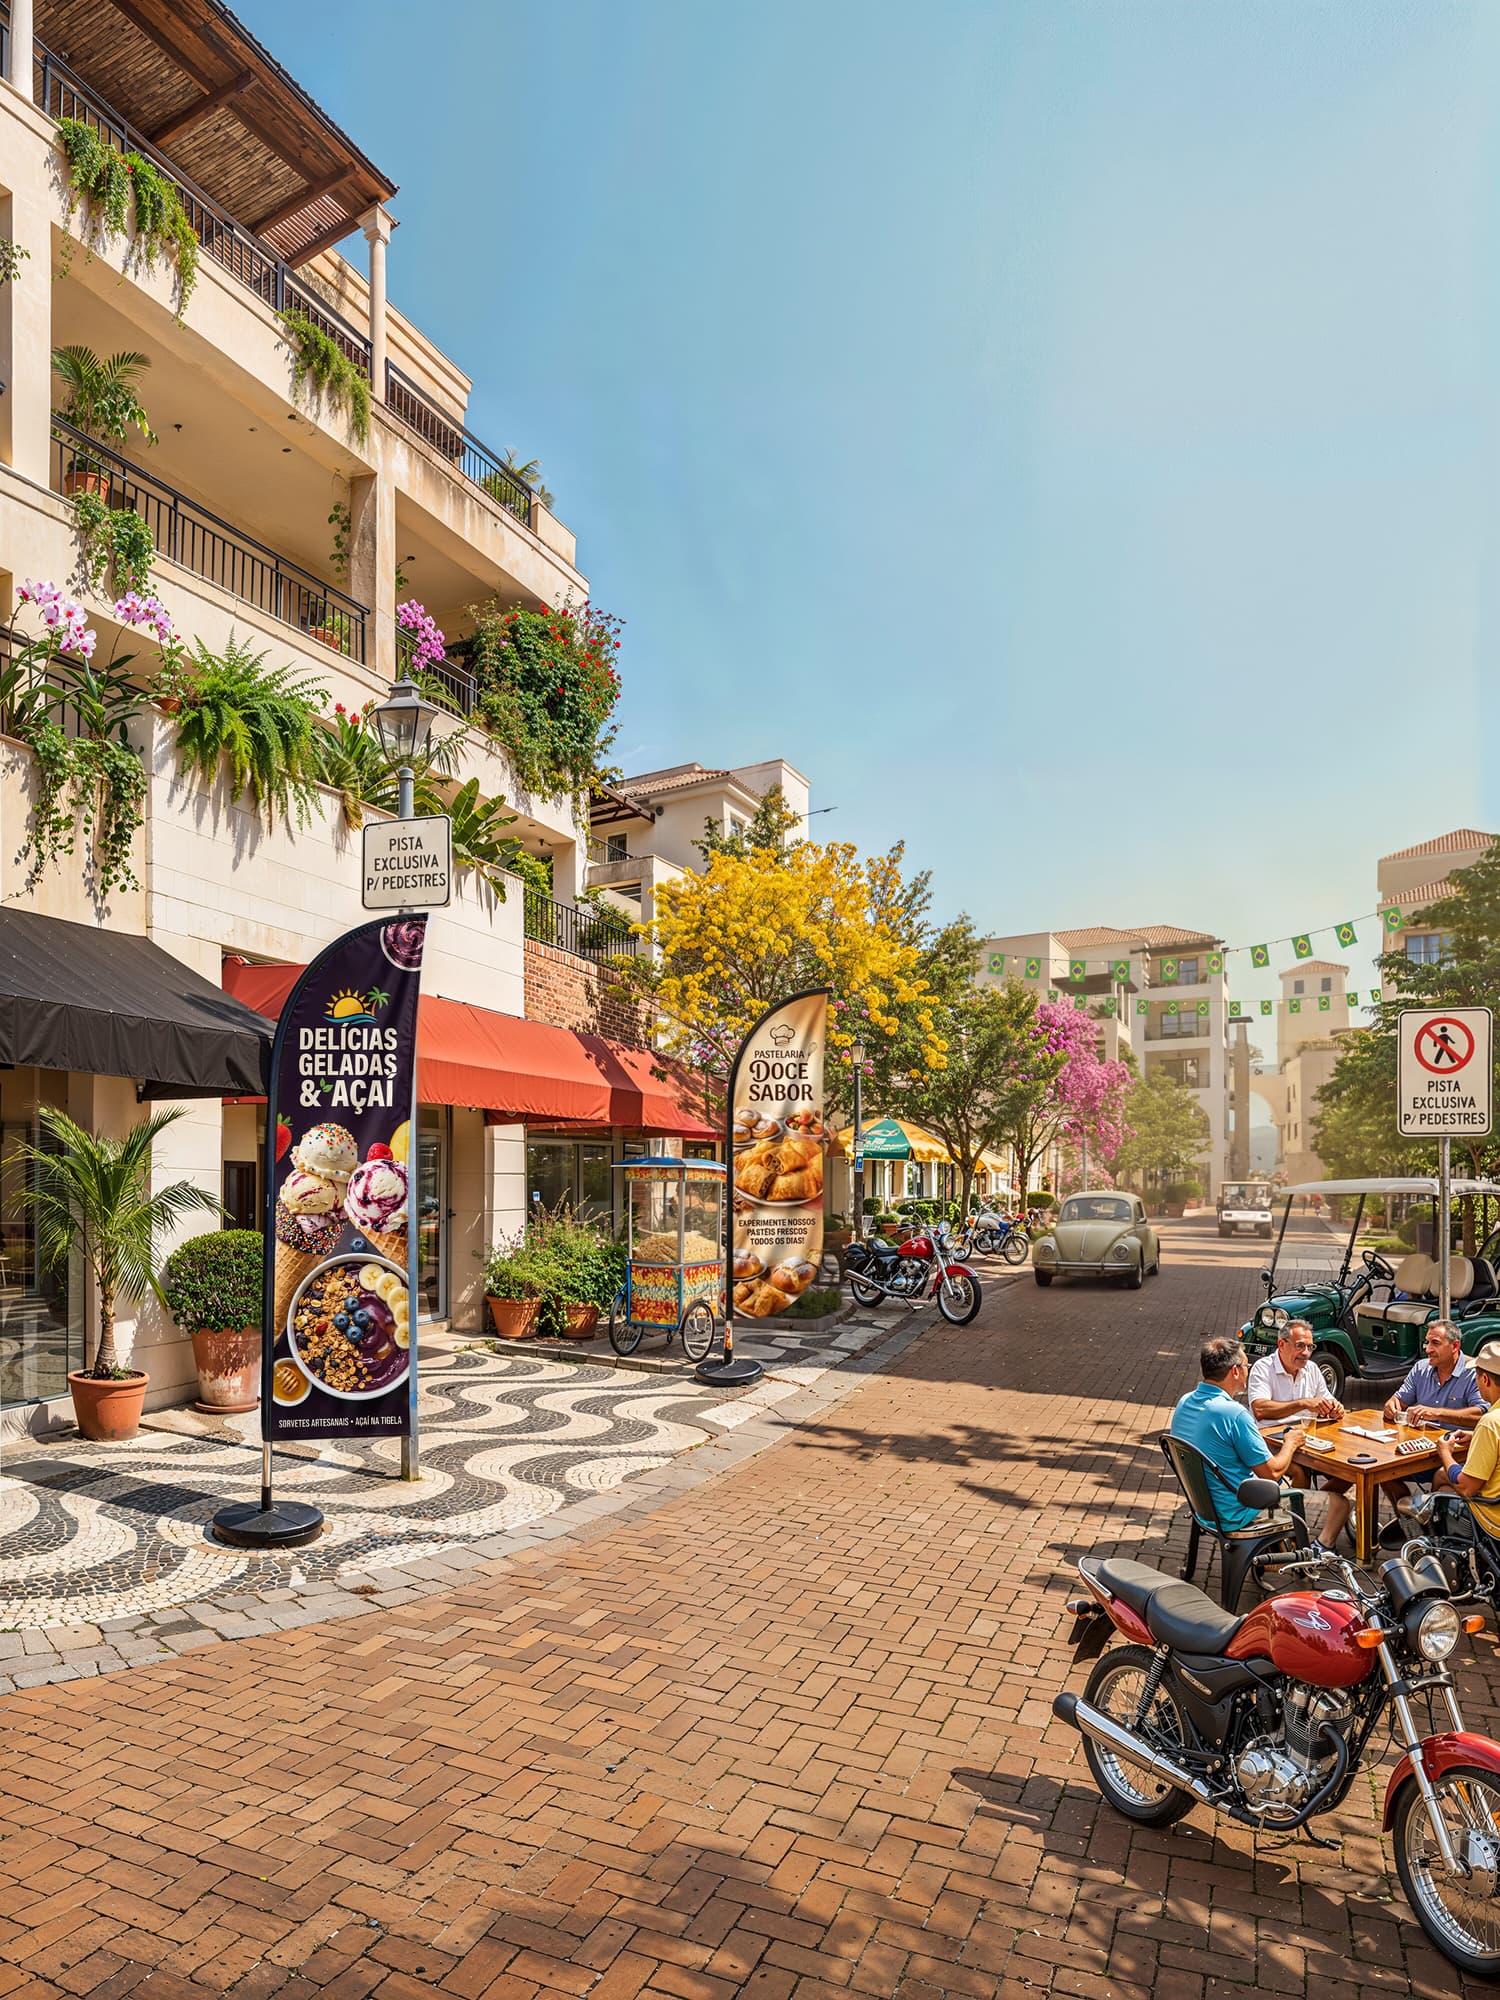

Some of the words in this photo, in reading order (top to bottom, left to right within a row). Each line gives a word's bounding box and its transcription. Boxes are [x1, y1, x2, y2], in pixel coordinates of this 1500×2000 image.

[389, 836, 423, 852] PISTA
[374, 853, 439, 872] EXCLUSIVA
[366, 876, 380, 891] P/
[382, 872, 447, 890] PEDESTRES
[299, 1022, 398, 1051] DELÍCIAS
[754, 1050, 805, 1059] PASTELARIA
[299, 1053, 398, 1076] GELADAS
[749, 1059, 809, 1083] DOCE
[299, 1079, 322, 1108] &
[331, 1073, 397, 1115] AÇAÍ
[748, 1083, 814, 1102] SABOR
[1427, 1080, 1461, 1093] PISTA
[1412, 1096, 1476, 1109] EXCLUSIVA
[1403, 1113, 1417, 1126] P/
[1419, 1112, 1486, 1126] PEDESTRES
[787, 1218, 816, 1226] NOSSOS
[746, 1227, 776, 1236] PASTÉIS
[776, 1227, 808, 1236] FRESCOS
[750, 1238, 774, 1246] TODOS
[786, 1237, 805, 1245] DIAS!
[278, 1419, 310, 1428] SORVETES
[311, 1418, 349, 1427] ARTESANAIS
[355, 1415, 370, 1427] AÇAÍ
[370, 1417, 380, 1425] NA
